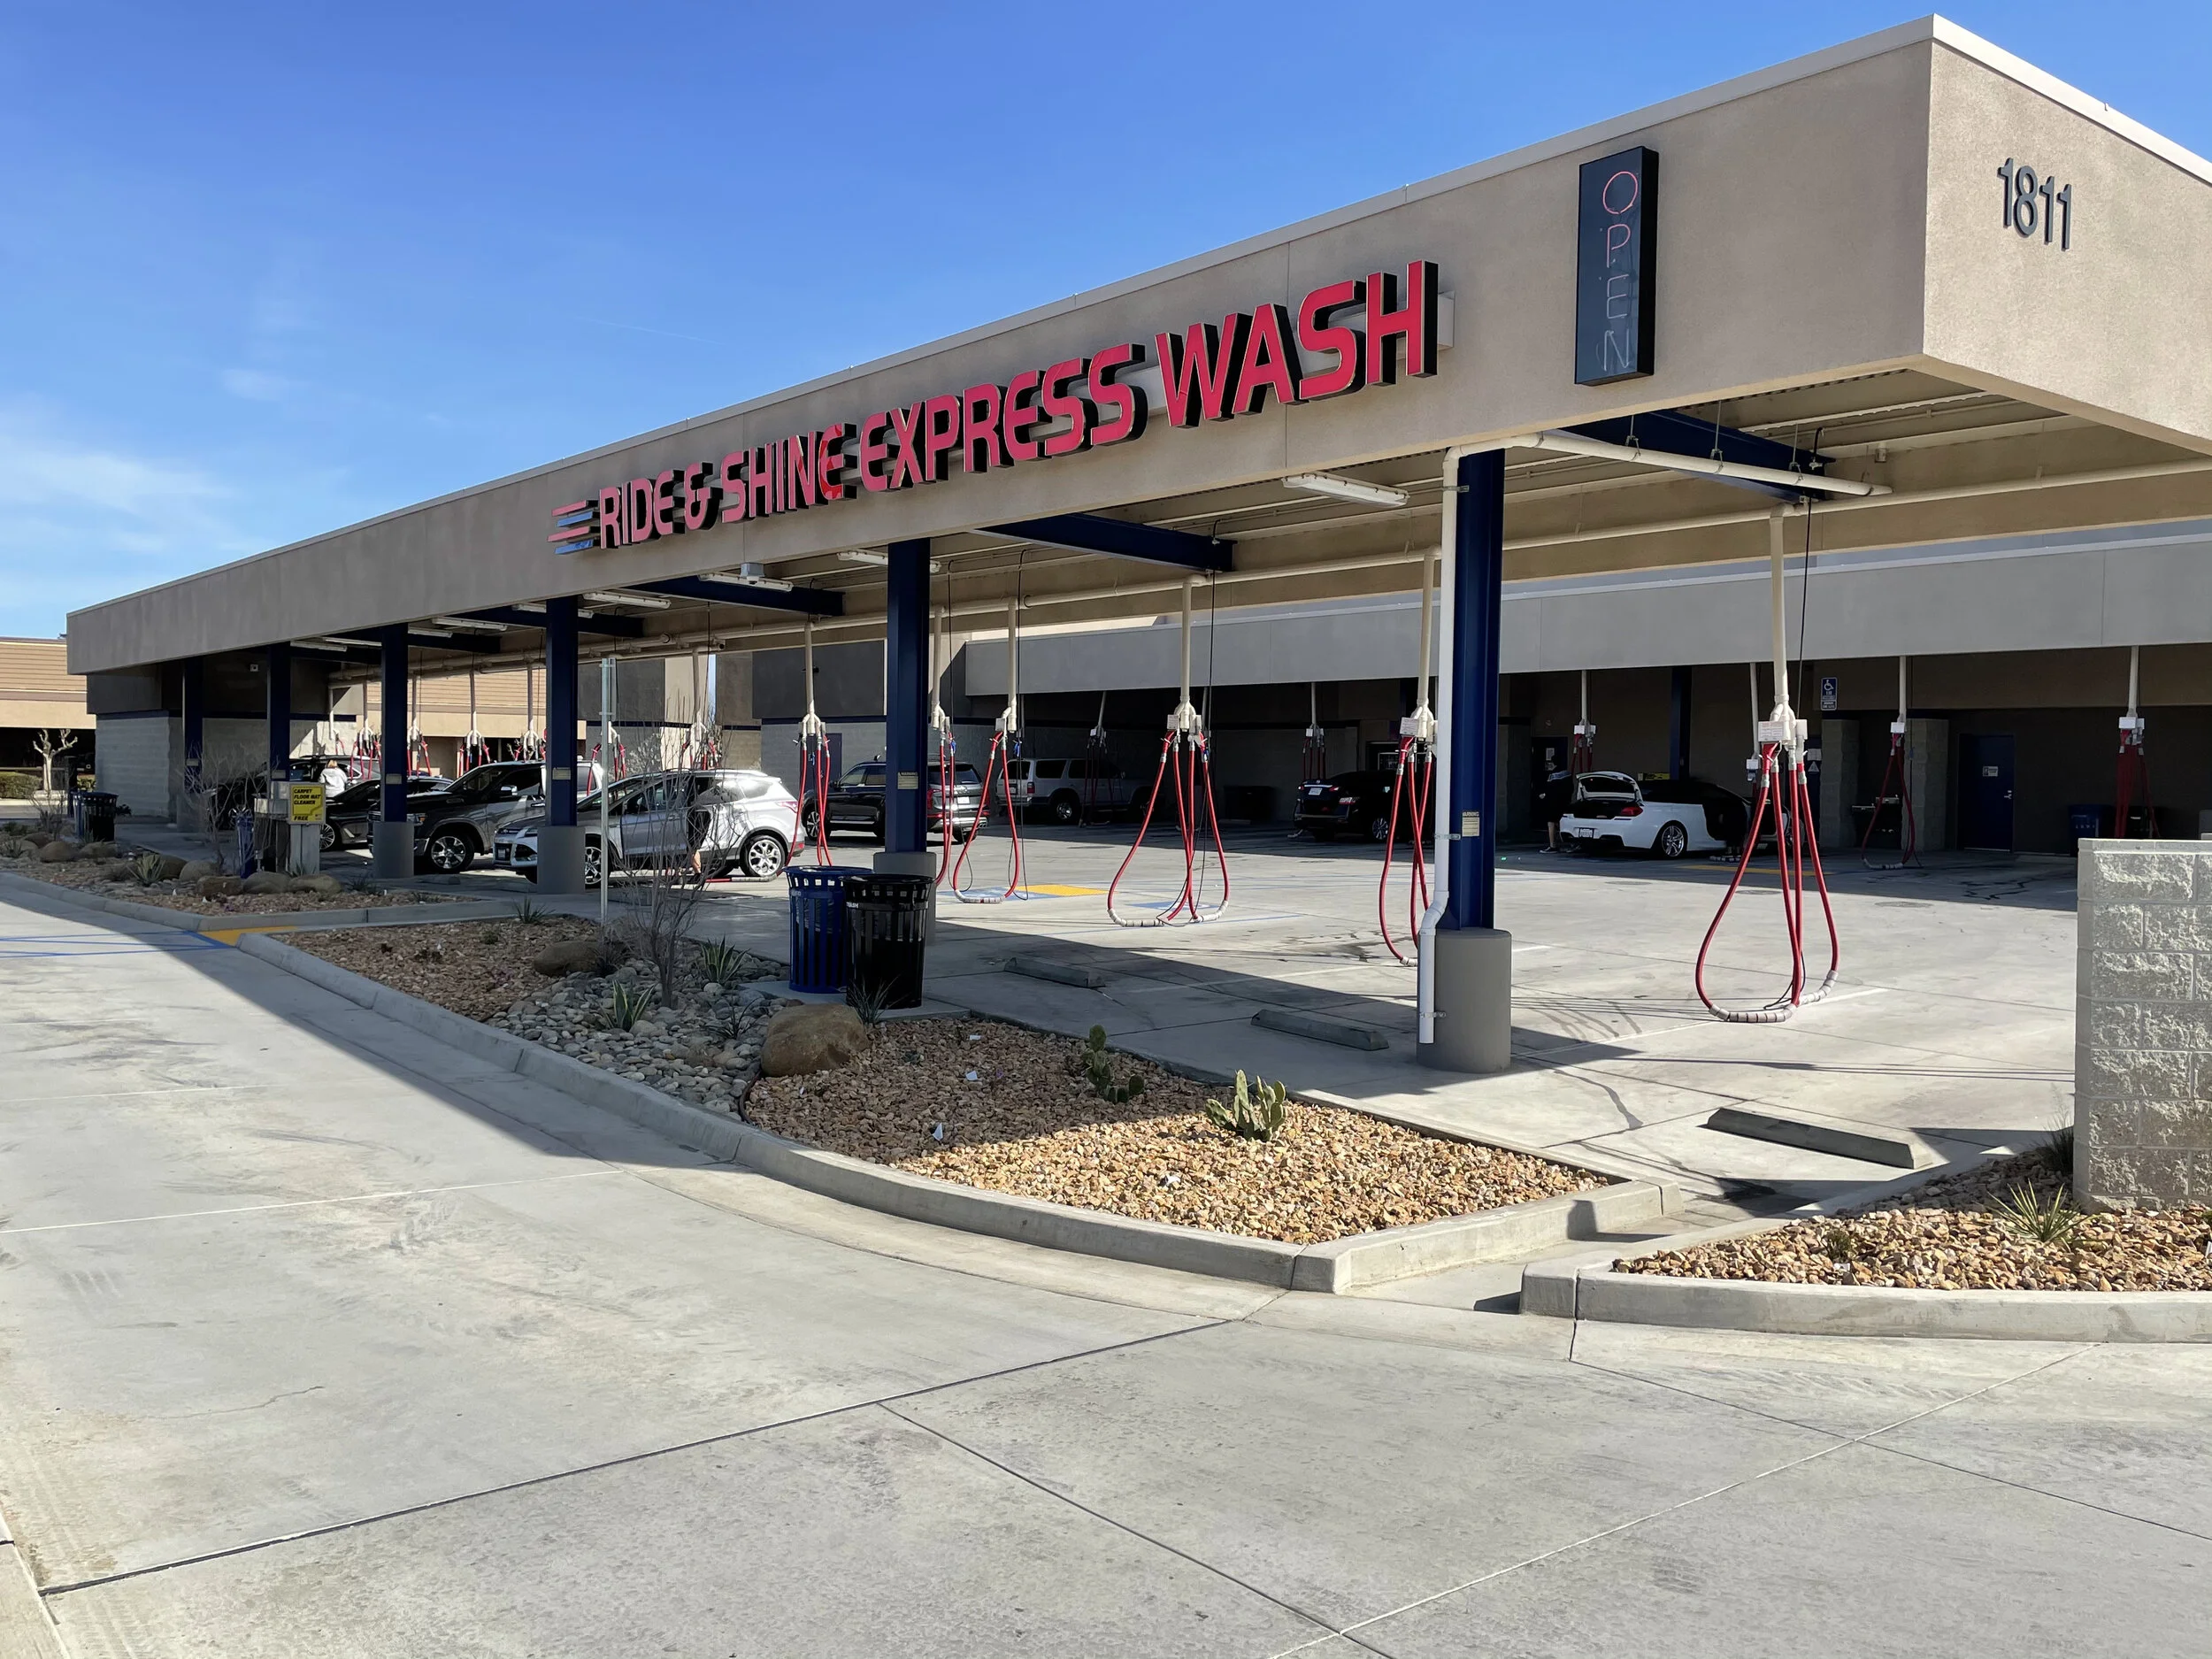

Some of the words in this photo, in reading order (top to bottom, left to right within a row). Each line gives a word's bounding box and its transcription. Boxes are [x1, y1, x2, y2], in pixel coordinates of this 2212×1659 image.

[1602, 170, 1639, 372] OPEN
[1997, 157, 2072, 251] 1811
[599, 469, 679, 550] RIDE
[683, 462, 720, 531] &
[720, 423, 851, 524] SHINE
[859, 342, 1143, 492] EXPRESS
[1154, 258, 1435, 428] WASH
